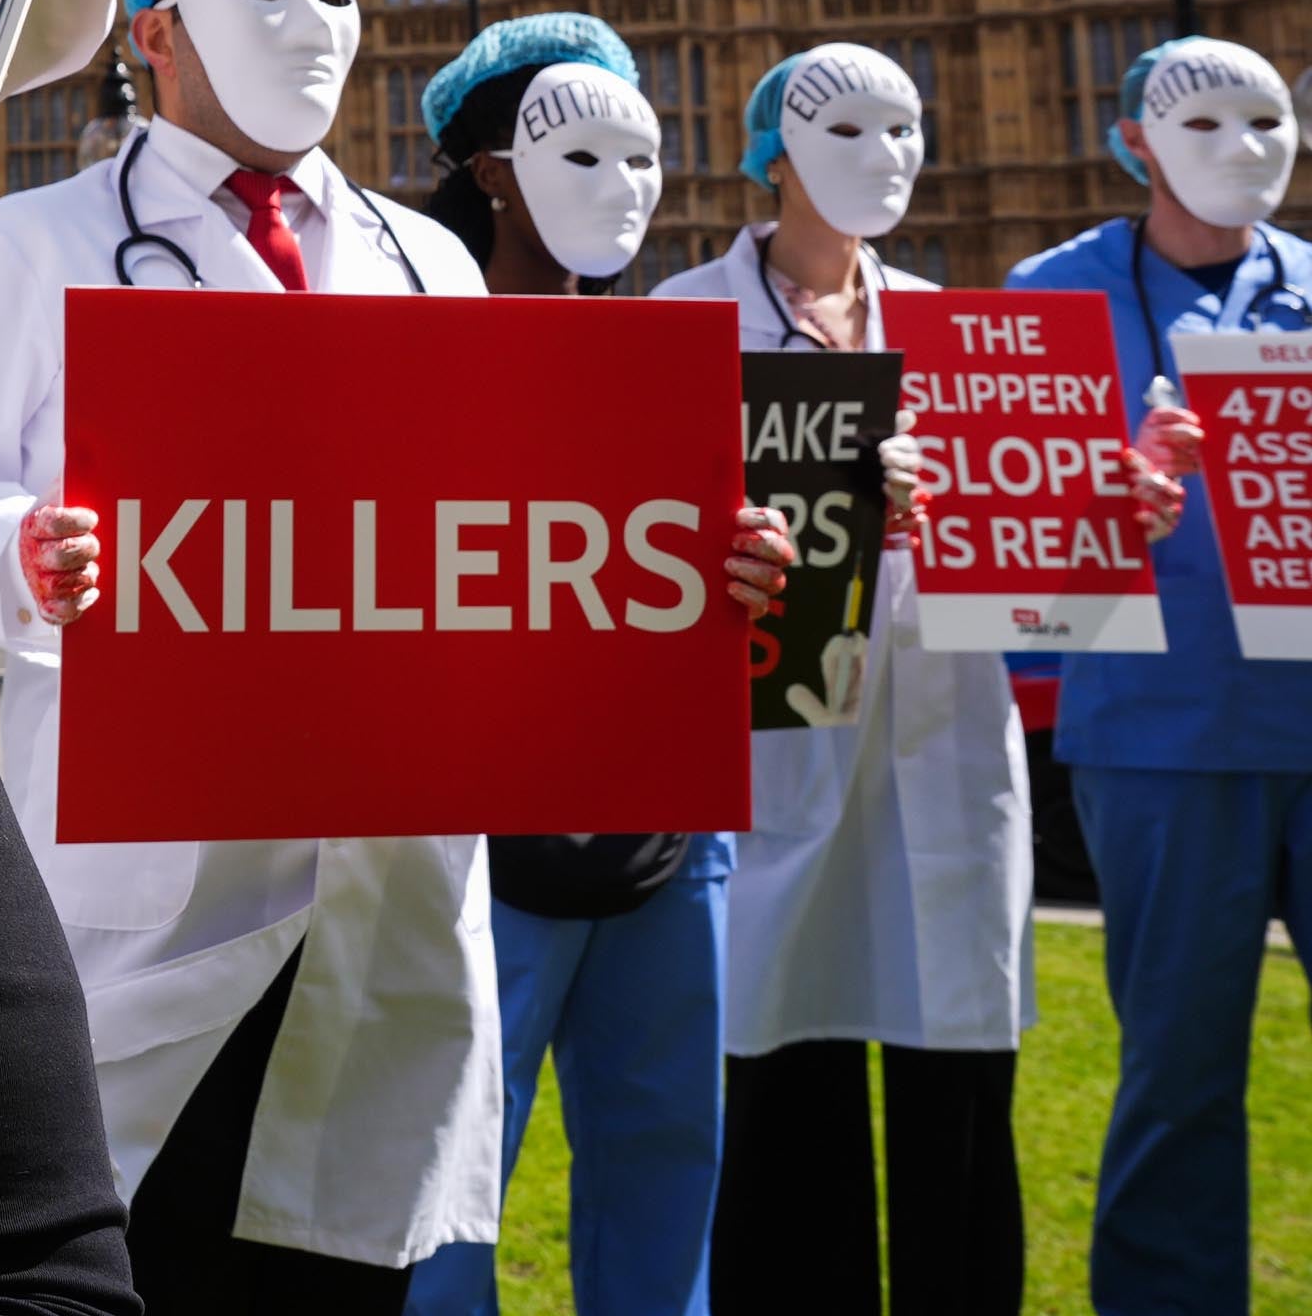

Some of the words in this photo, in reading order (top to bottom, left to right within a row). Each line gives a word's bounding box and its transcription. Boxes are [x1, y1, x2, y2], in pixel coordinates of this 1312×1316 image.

[950, 314, 1047, 355] THE
[900, 371, 1111, 415] SLIPPERY
[742, 401, 864, 463] AKE
[921, 436, 1127, 497] SLOPE
[744, 490, 853, 568] RS
[919, 515, 977, 569] IS
[990, 517, 1143, 570] REAL
[115, 498, 708, 633] KILLERS
